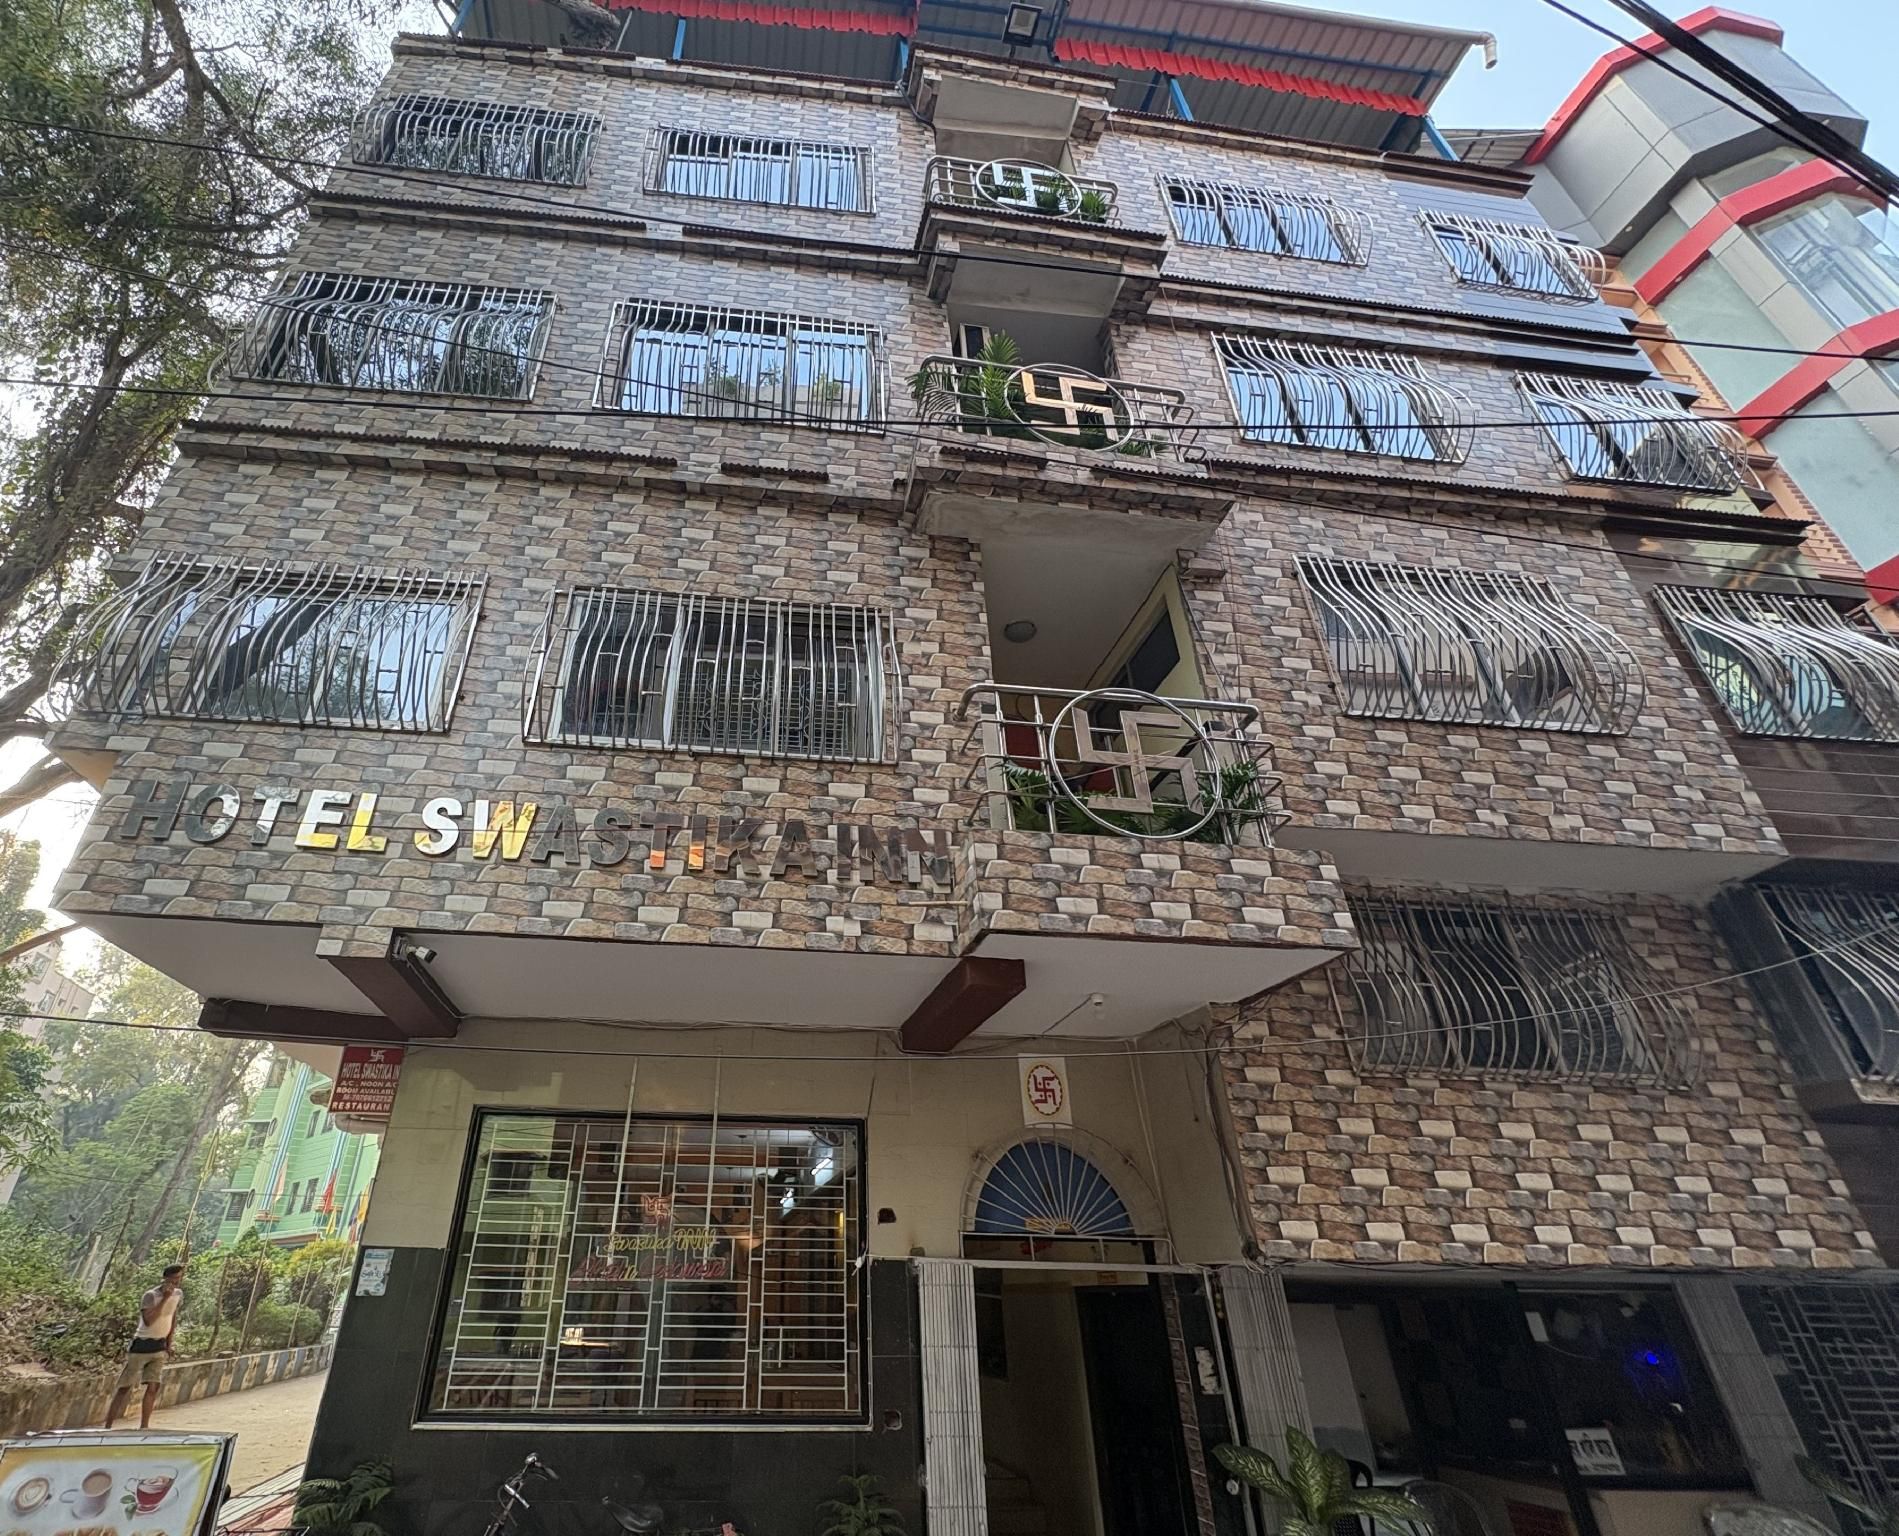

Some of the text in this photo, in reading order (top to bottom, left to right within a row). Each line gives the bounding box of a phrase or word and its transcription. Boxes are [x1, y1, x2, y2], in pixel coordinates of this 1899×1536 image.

[120, 778, 951, 884] HOTEL SWASTIKA INN
[341, 1063, 361, 1078] HOTEL
[361, 1063, 392, 1079] SWASTIKA
